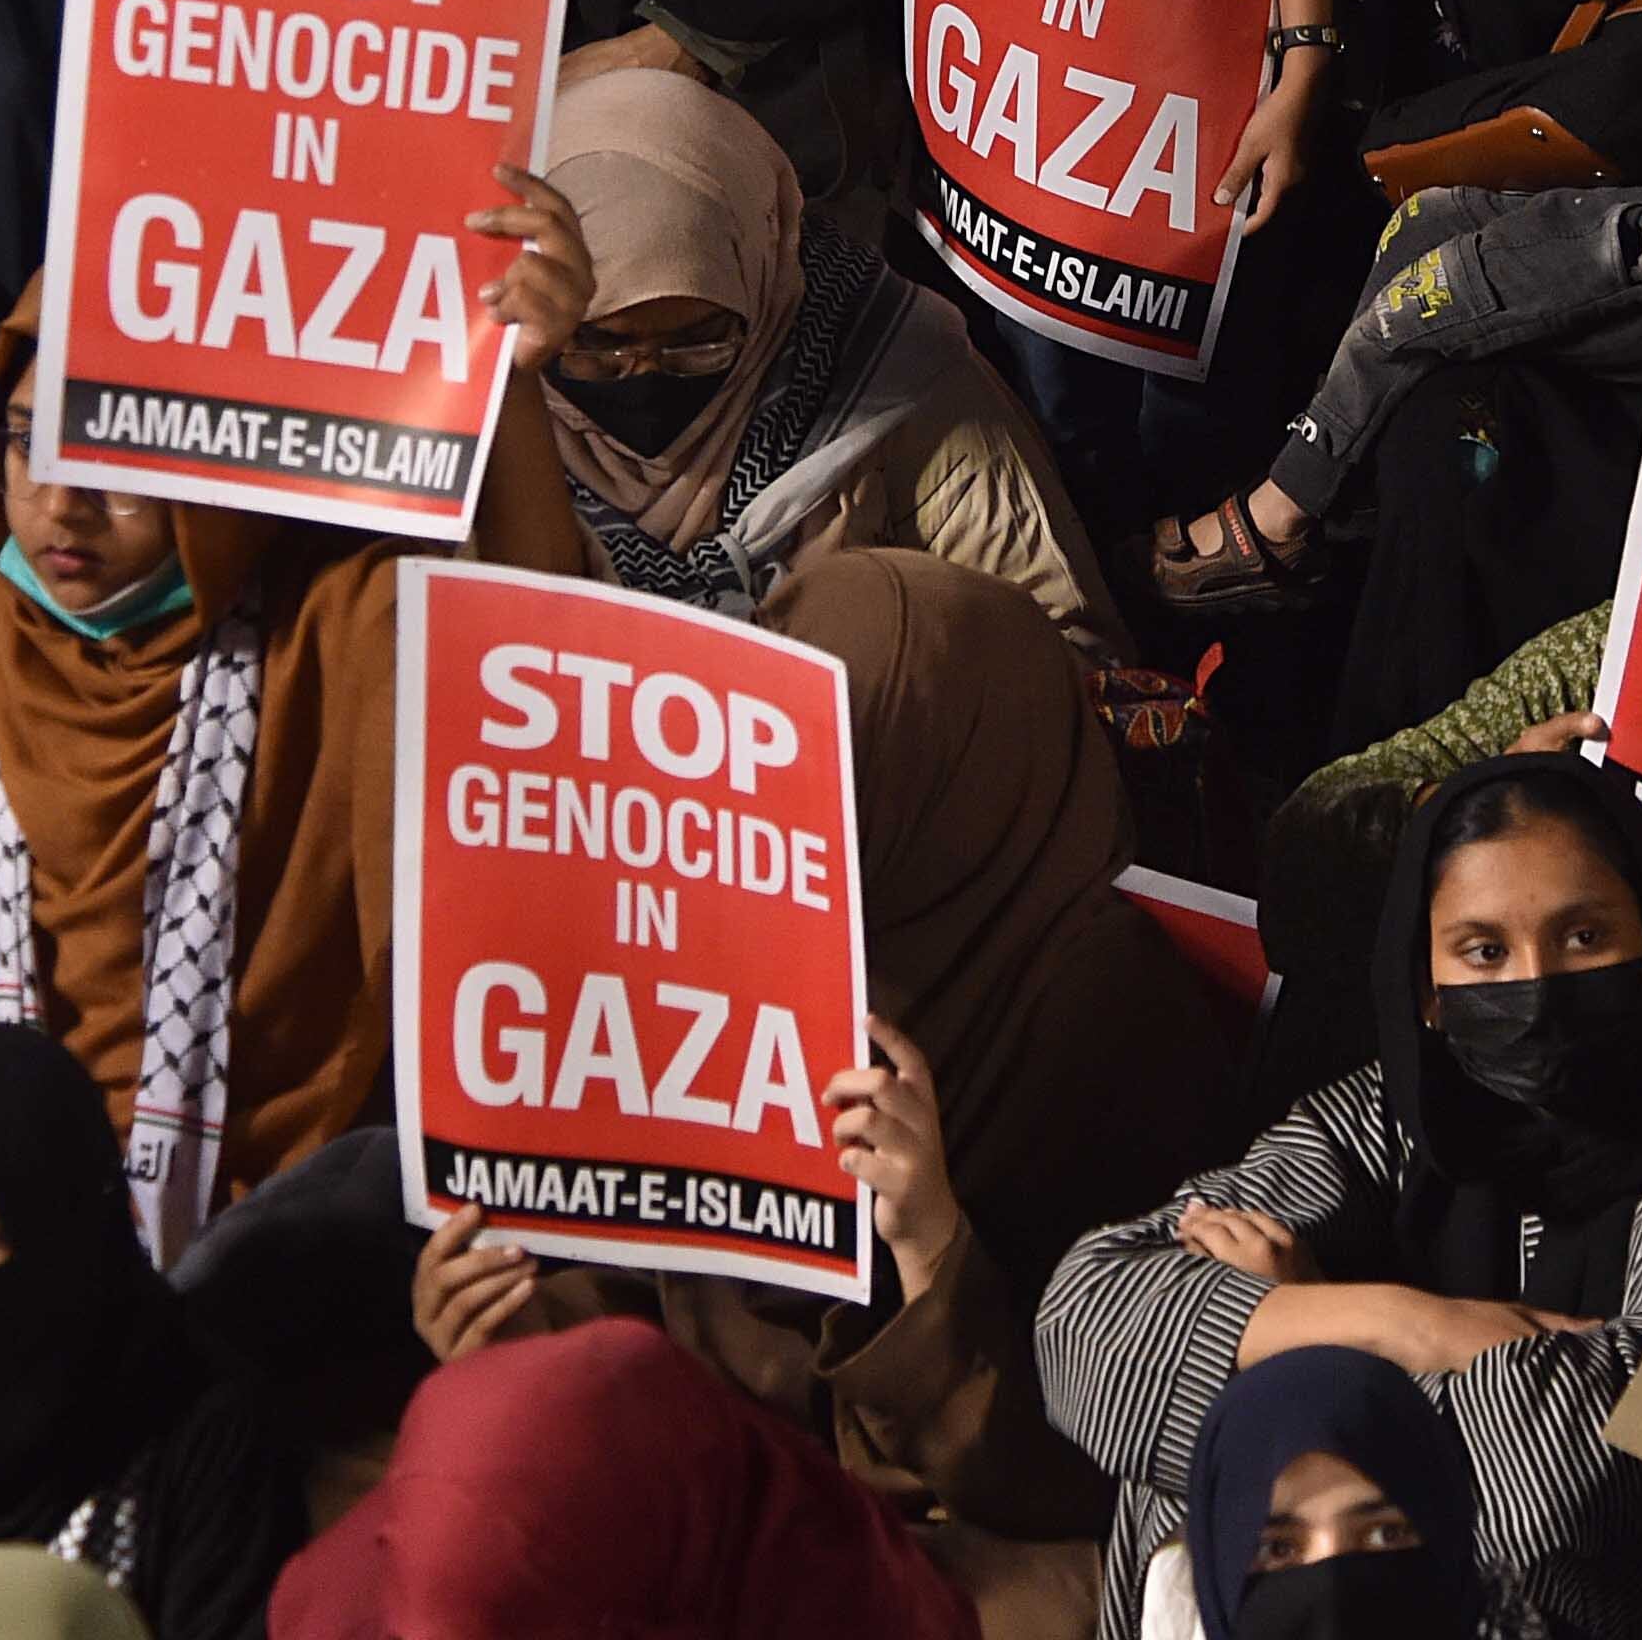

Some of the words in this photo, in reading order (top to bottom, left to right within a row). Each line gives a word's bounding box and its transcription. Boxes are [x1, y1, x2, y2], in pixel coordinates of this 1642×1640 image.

[271, 112, 340, 186] IN
[925, 2, 1200, 235] GAZA
[108, 192, 468, 384] GAZA
[84, 390, 462, 492] JAMAAT-E-ISLAMI
[478, 643, 799, 795] STOP
[446, 764, 831, 912] GENOCIDE
[615, 879, 678, 953] IN
[452, 960, 824, 1150] GAZA
[446, 1151, 836, 1250] JAMAAT-E-ISLAMI
